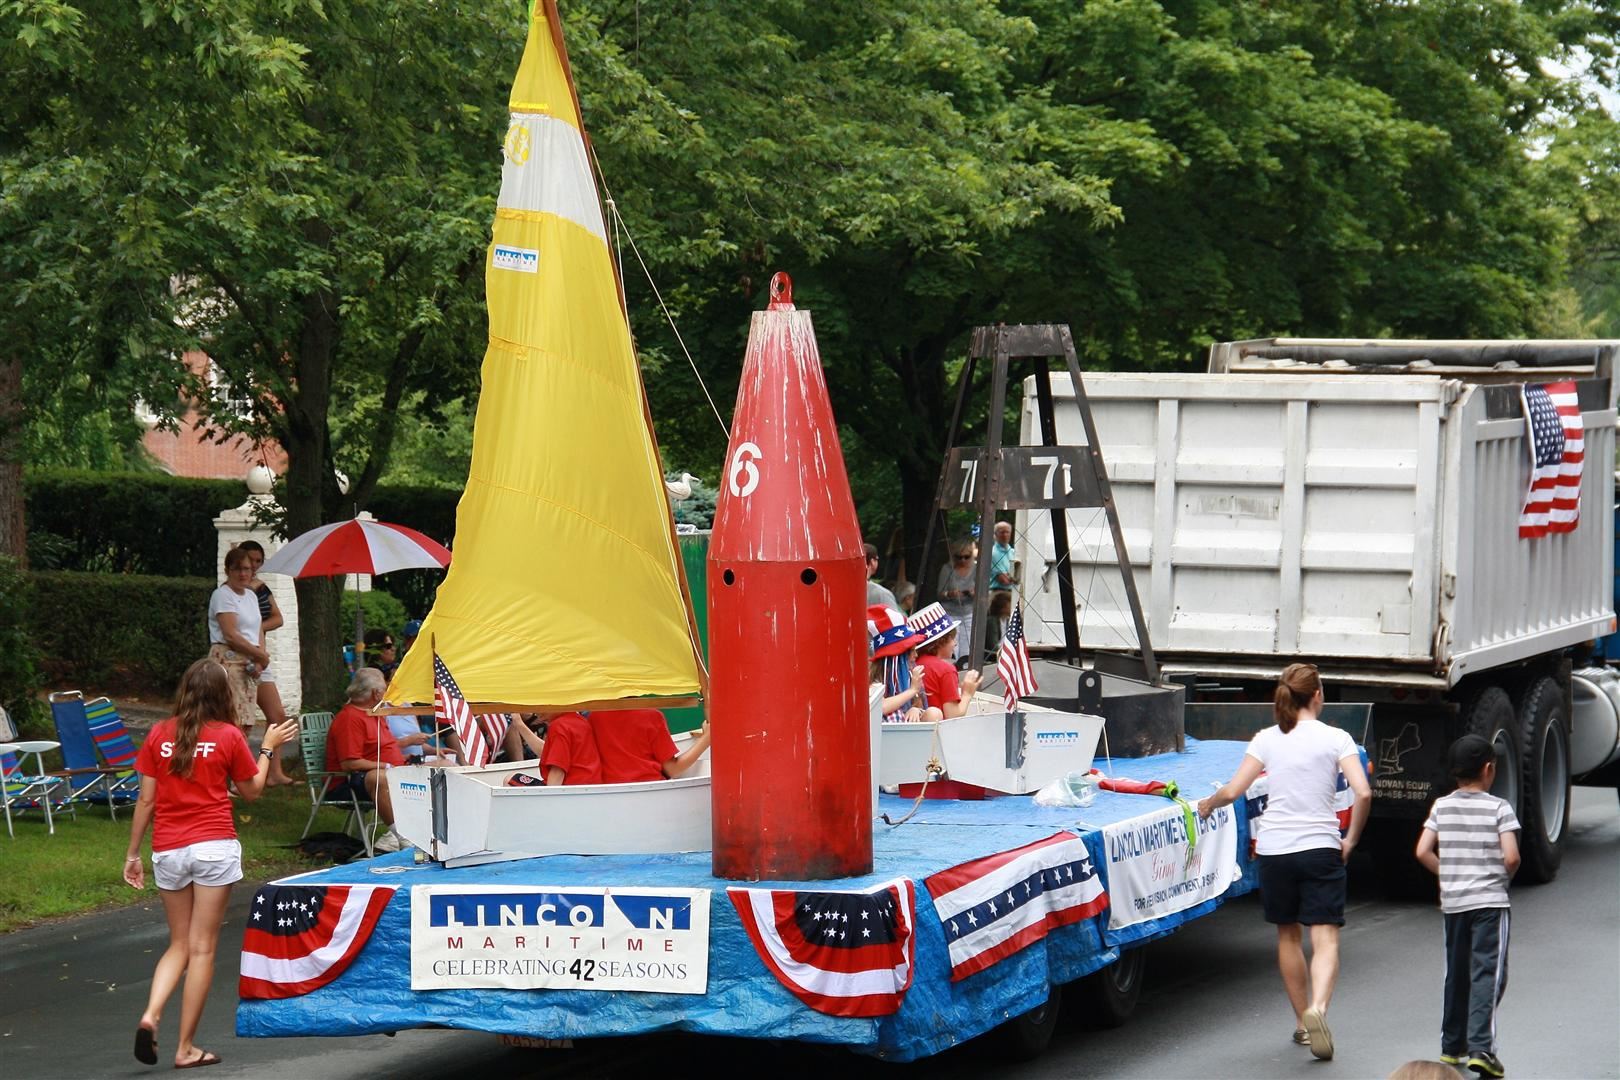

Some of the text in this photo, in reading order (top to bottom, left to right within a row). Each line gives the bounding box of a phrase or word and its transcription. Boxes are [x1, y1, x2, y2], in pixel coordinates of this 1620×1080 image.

[729, 441, 763, 498] 6
[160, 741, 217, 758] SFF
[1376, 778, 1405, 790] NOVAN
[1143, 817, 1180, 853] MARITIME
[1134, 897, 1146, 911] FOR
[447, 936, 674, 952] MARITIME
[432, 957, 688, 982] CELEBRATING 42 SEASONS
